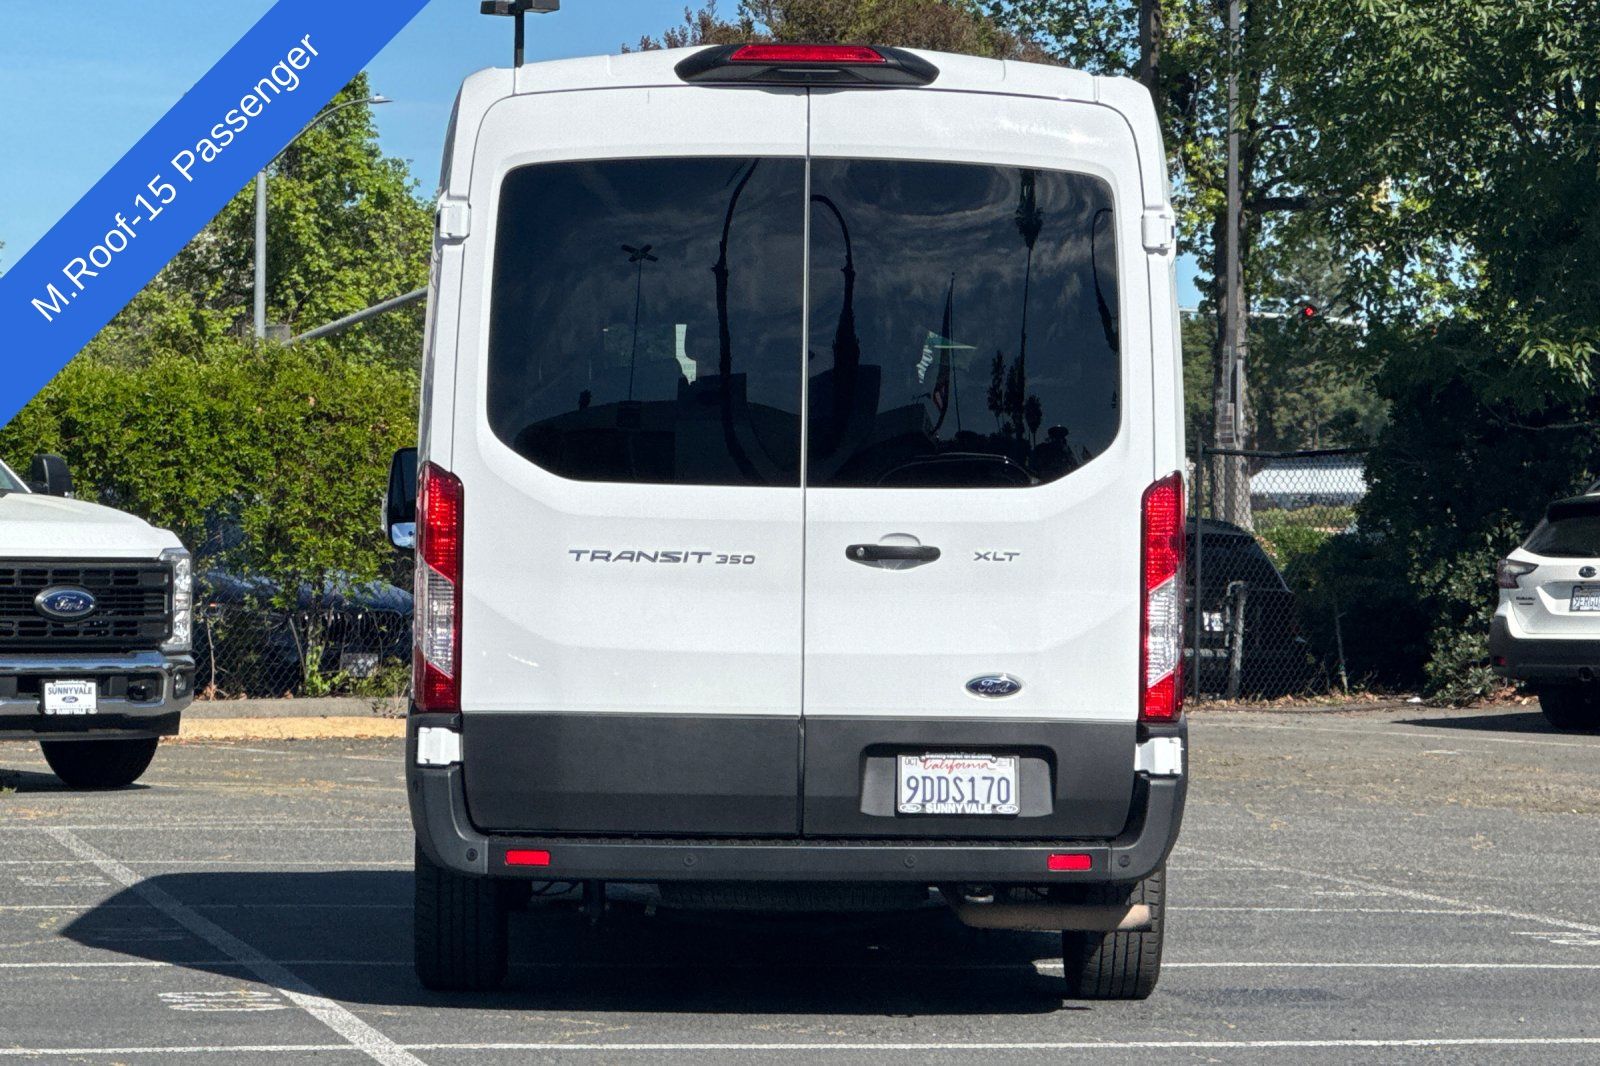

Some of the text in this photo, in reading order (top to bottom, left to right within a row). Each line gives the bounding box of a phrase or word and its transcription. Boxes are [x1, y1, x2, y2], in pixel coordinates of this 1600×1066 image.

[568, 549, 756, 565] TRANSIT 350
[973, 551, 1021, 562] XLT
[54, 595, 85, 611] Ford
[47, 686, 93, 696] SUNNYVALE
[977, 679, 1011, 693] Ford
[922, 758, 996, 774] California
[906, 775, 1011, 804] 9DDS170
[925, 803, 993, 814] SUNNYVALE
